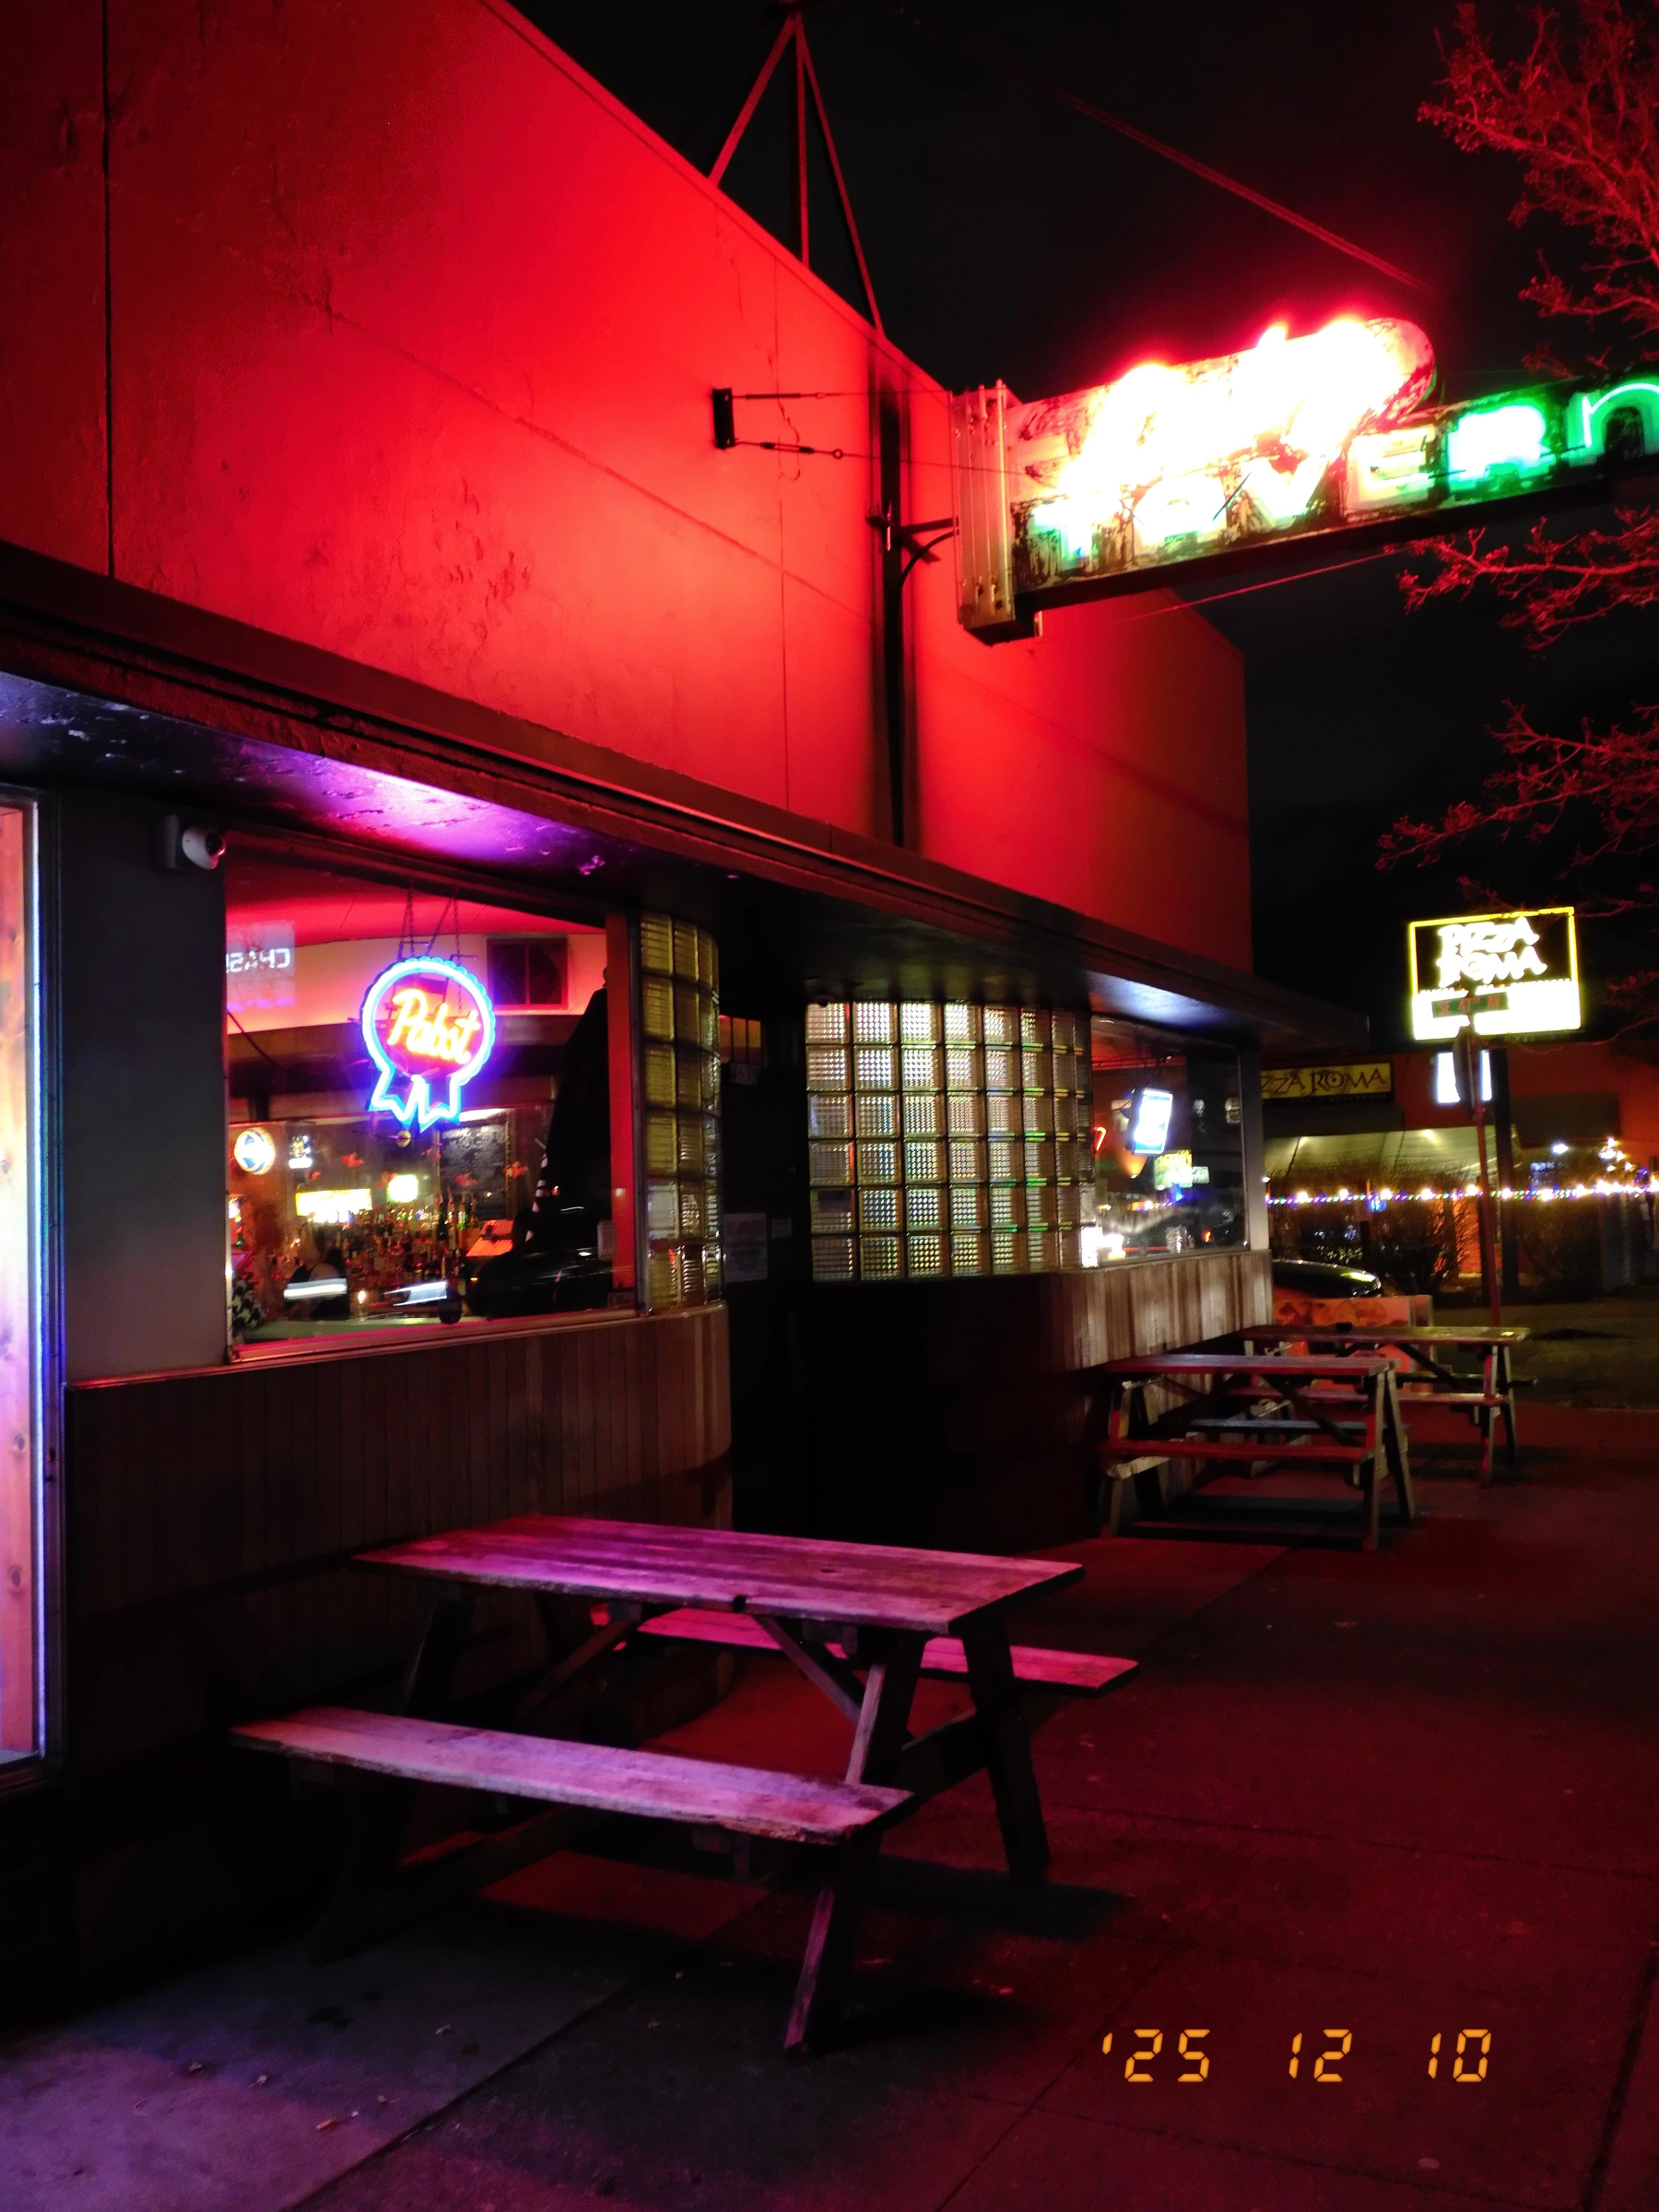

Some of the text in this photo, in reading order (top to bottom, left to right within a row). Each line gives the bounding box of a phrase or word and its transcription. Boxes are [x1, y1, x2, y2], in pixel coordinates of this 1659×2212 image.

[1438, 916, 1539, 957] PIZZA
[1436, 946, 1547, 988] ROMA
[387, 988, 480, 1064] Pabst
[1261, 1066, 1386, 1094] ZZA ROMA
